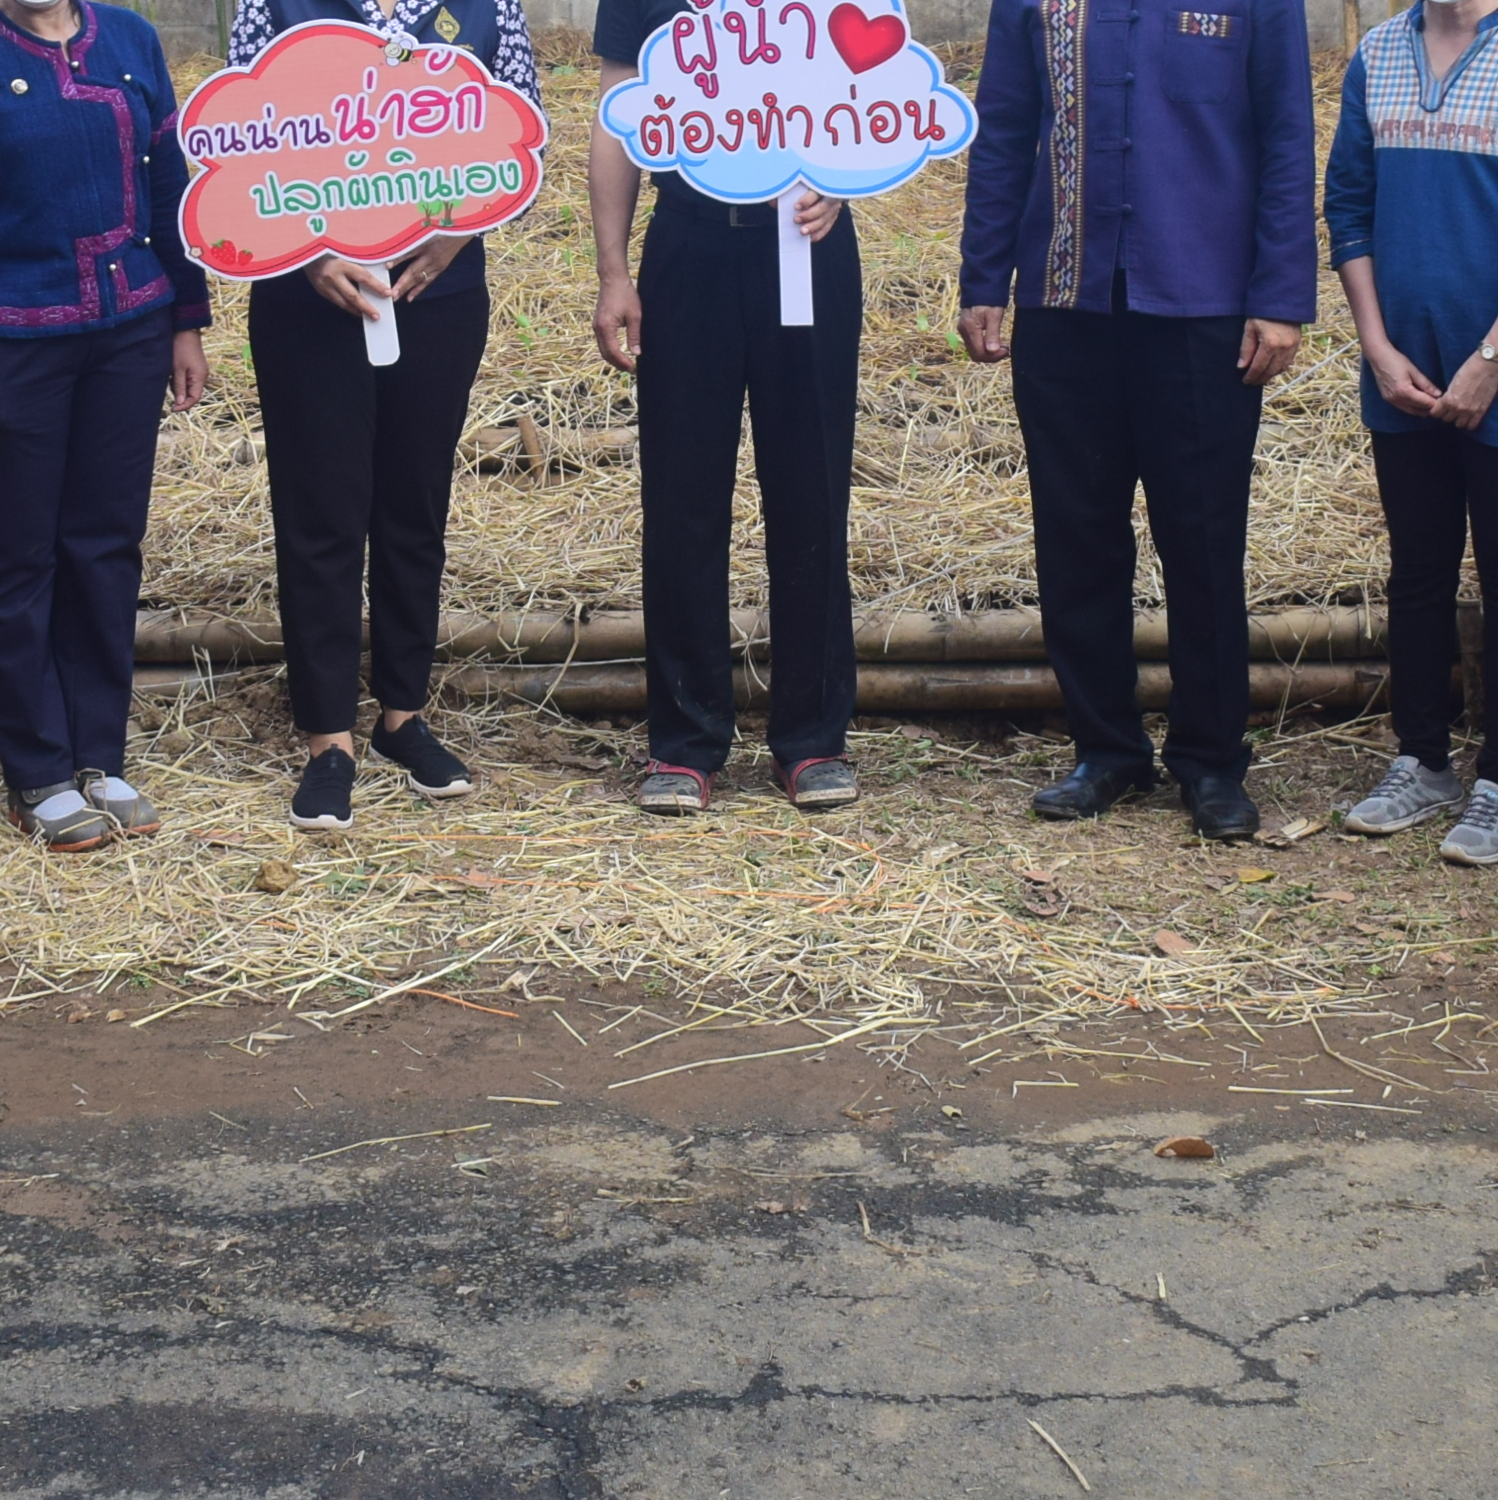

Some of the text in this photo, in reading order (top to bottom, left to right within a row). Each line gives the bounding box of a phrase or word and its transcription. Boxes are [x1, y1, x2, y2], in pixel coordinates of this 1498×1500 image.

[640, 84, 946, 157] ต้องทำก่อน
[252, 150, 523, 235] ปลูกผักกินเอง
